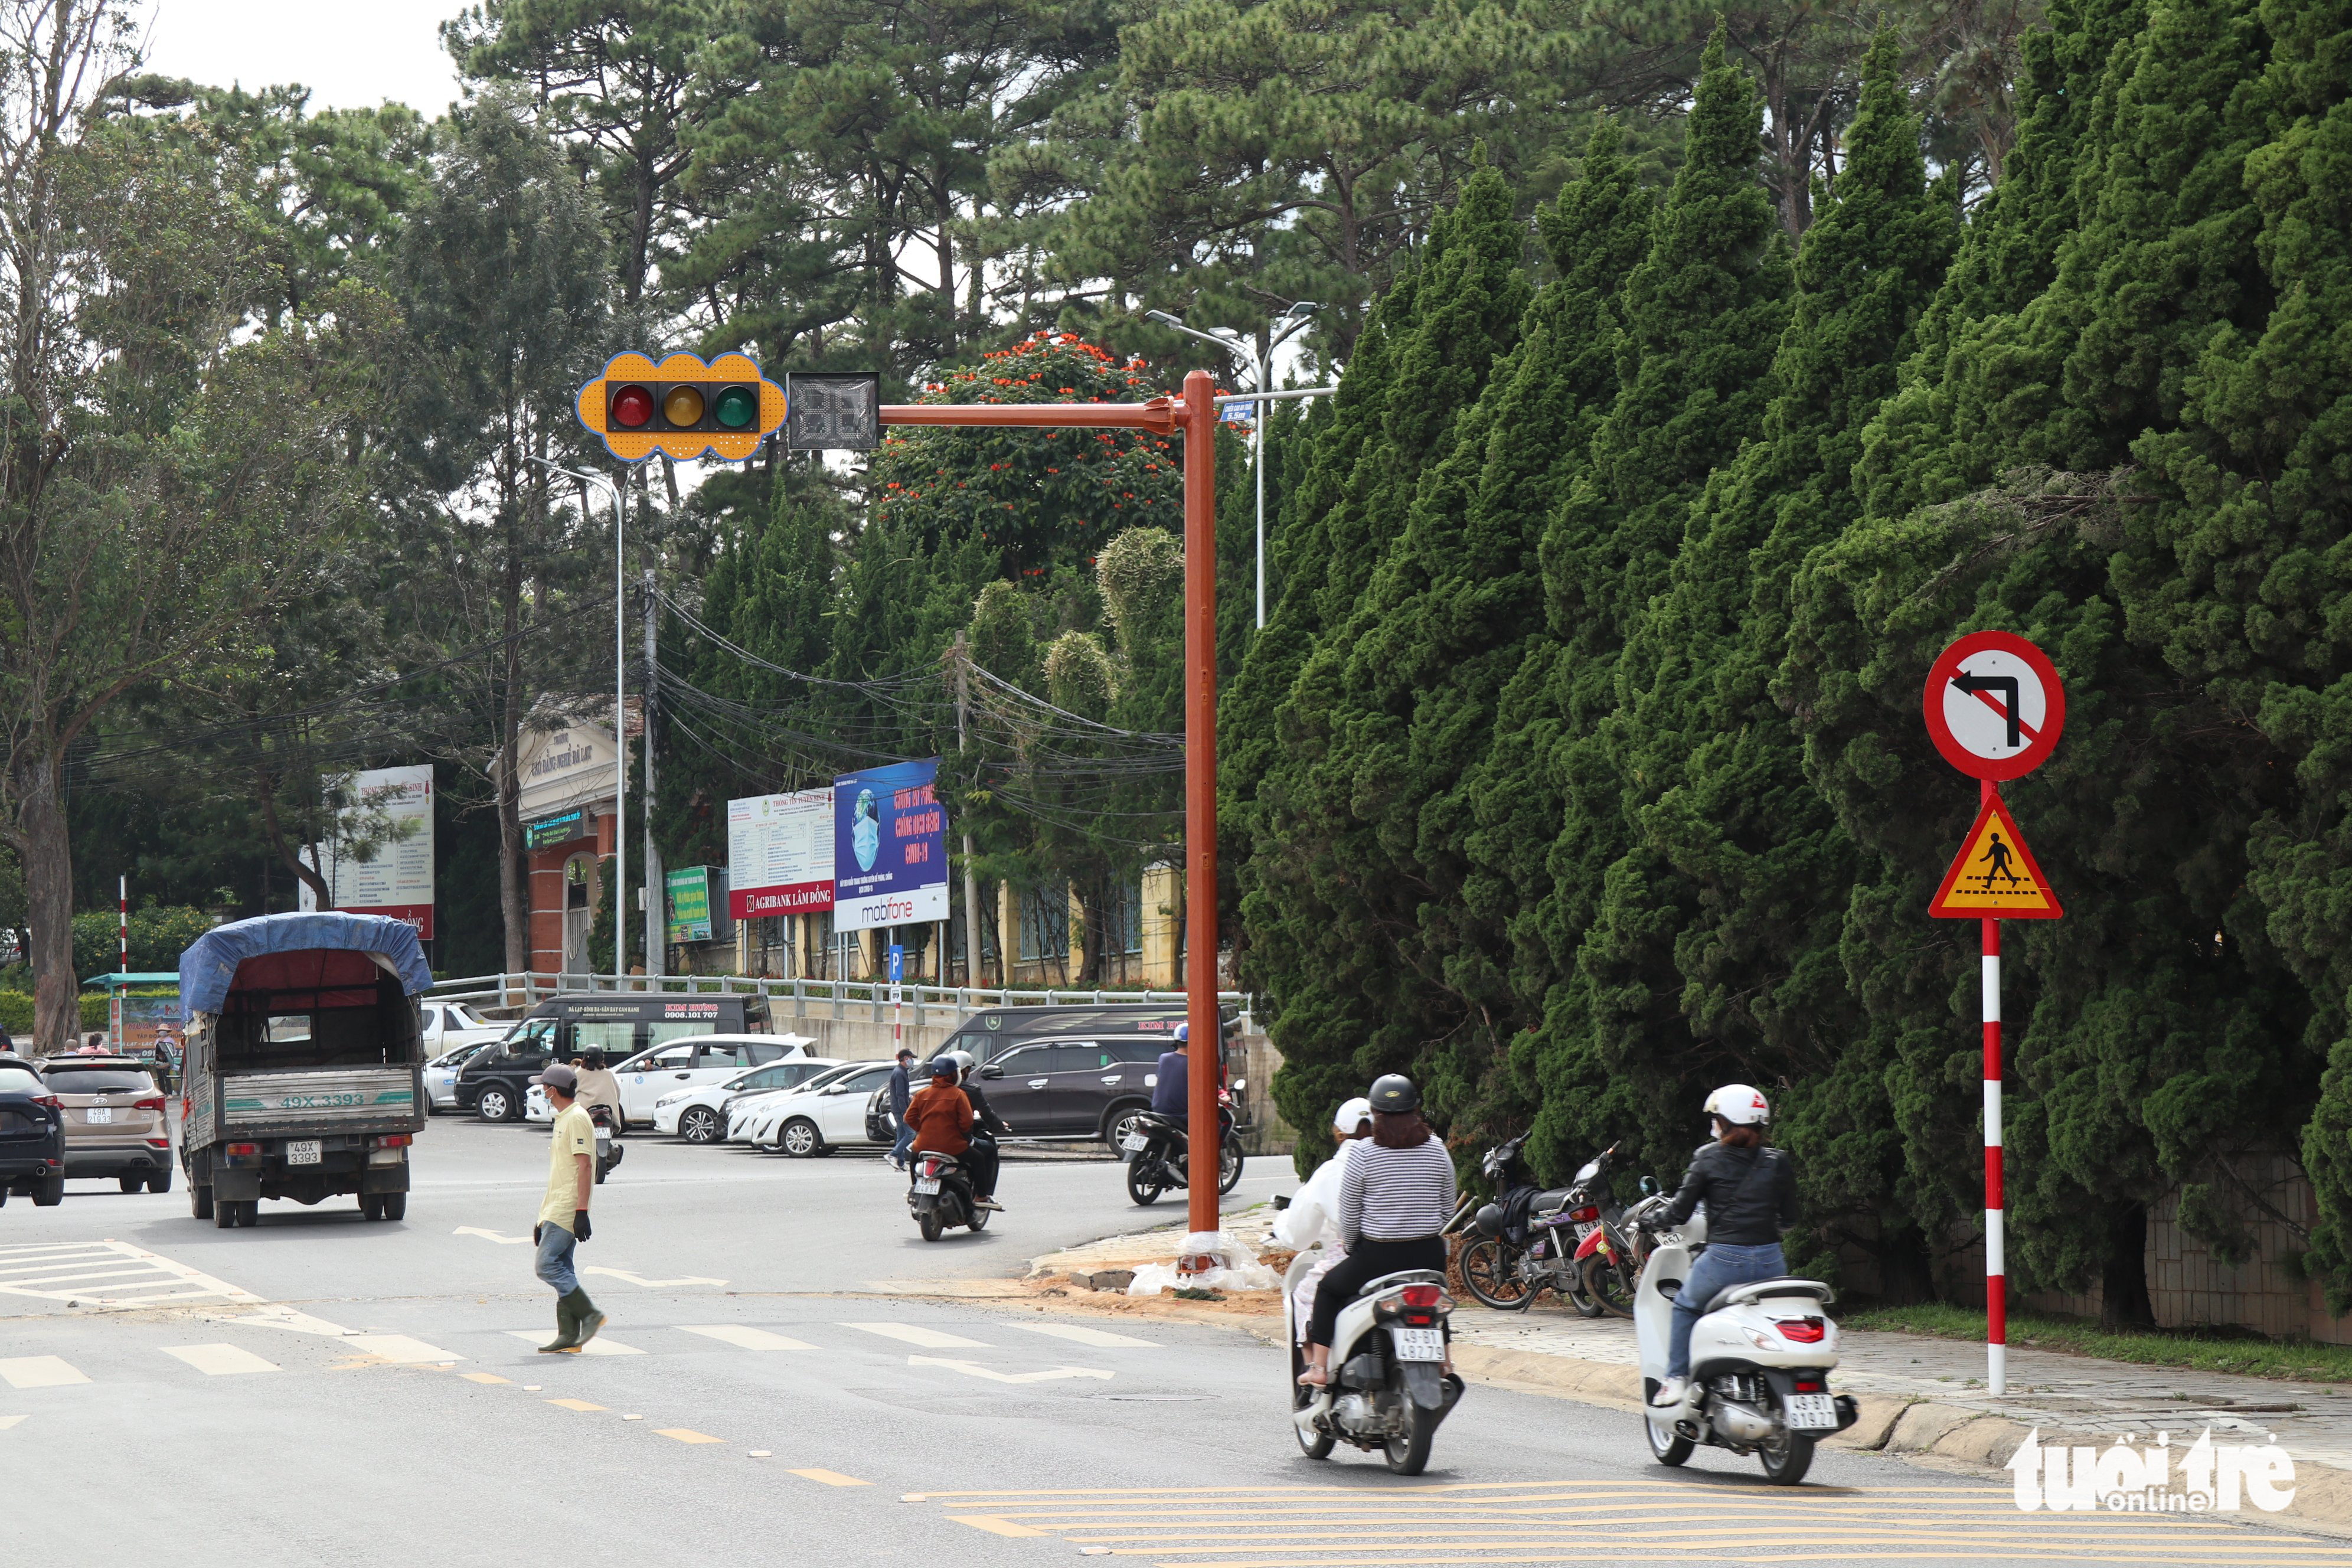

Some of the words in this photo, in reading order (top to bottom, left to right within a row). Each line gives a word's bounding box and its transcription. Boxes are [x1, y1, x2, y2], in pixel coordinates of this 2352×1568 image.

[532, 762, 541, 776] CAO
[409, 783, 422, 792] SINH
[773, 798, 788, 807] THÔNG
[894, 788, 910, 810] CHUNG
[896, 809, 912, 838] CHỐNG
[913, 814, 925, 839] DỊCH
[926, 808, 939, 837] BỆNH
[905, 841, 927, 865] COVID-19
[756, 894, 790, 909] AGRIBANK
[793, 888, 809, 905] LÂM
[810, 884, 831, 904] ĐỒNG
[862, 896, 913, 923] mobifone
[893, 952, 900, 975] P
[1137, 1021, 1164, 1030] KIM
[280, 1094, 364, 1108] 49X.3393
[295, 1142, 314, 1153] 49X
[291, 1152, 318, 1163] 3393
[1404, 1330, 1436, 1345] 49-B1
[1794, 1396, 1828, 1410] 49-B1
